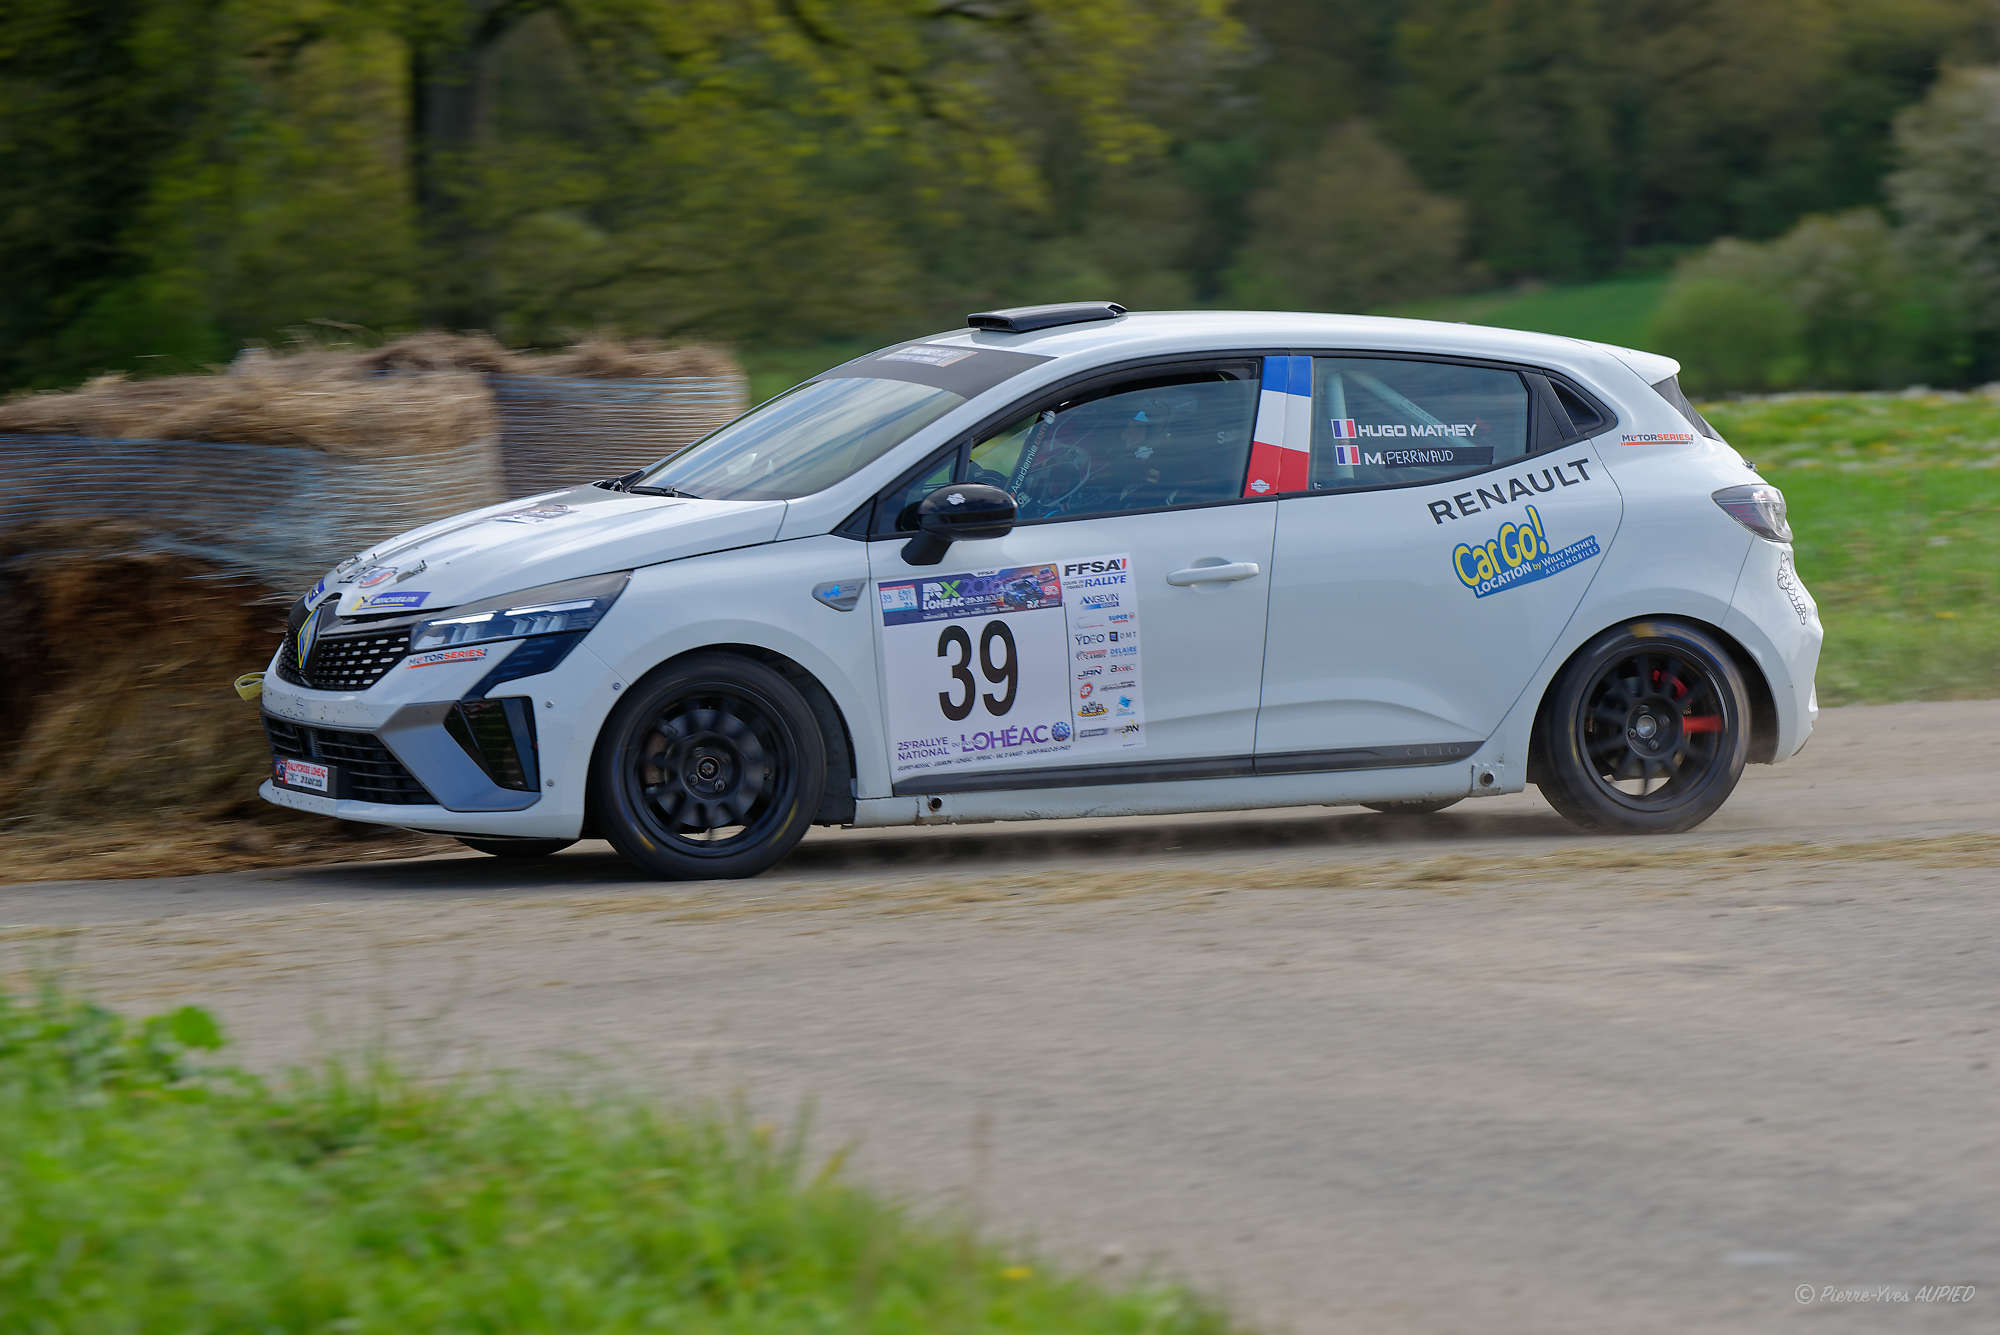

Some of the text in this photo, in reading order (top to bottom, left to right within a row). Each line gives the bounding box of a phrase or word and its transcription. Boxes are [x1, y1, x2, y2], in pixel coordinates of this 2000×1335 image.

[1358, 424, 1477, 437] HUGO MATHEY
[1427, 458, 1591, 525] RENAULT
[1064, 560, 1121, 577] FFSA
[1475, 561, 1532, 595] LOCATION
[1565, 537, 1594, 556] MATHEY
[1545, 546, 1599, 576] AUTOMOBILES
[1085, 575, 1127, 587] RALLYE
[922, 597, 964, 611] LOHEAC
[937, 619, 1018, 721] 39
[911, 736, 949, 749] RALLYE
[961, 725, 1049, 753] LOHÉAC
[897, 747, 950, 761] NATIONAL
